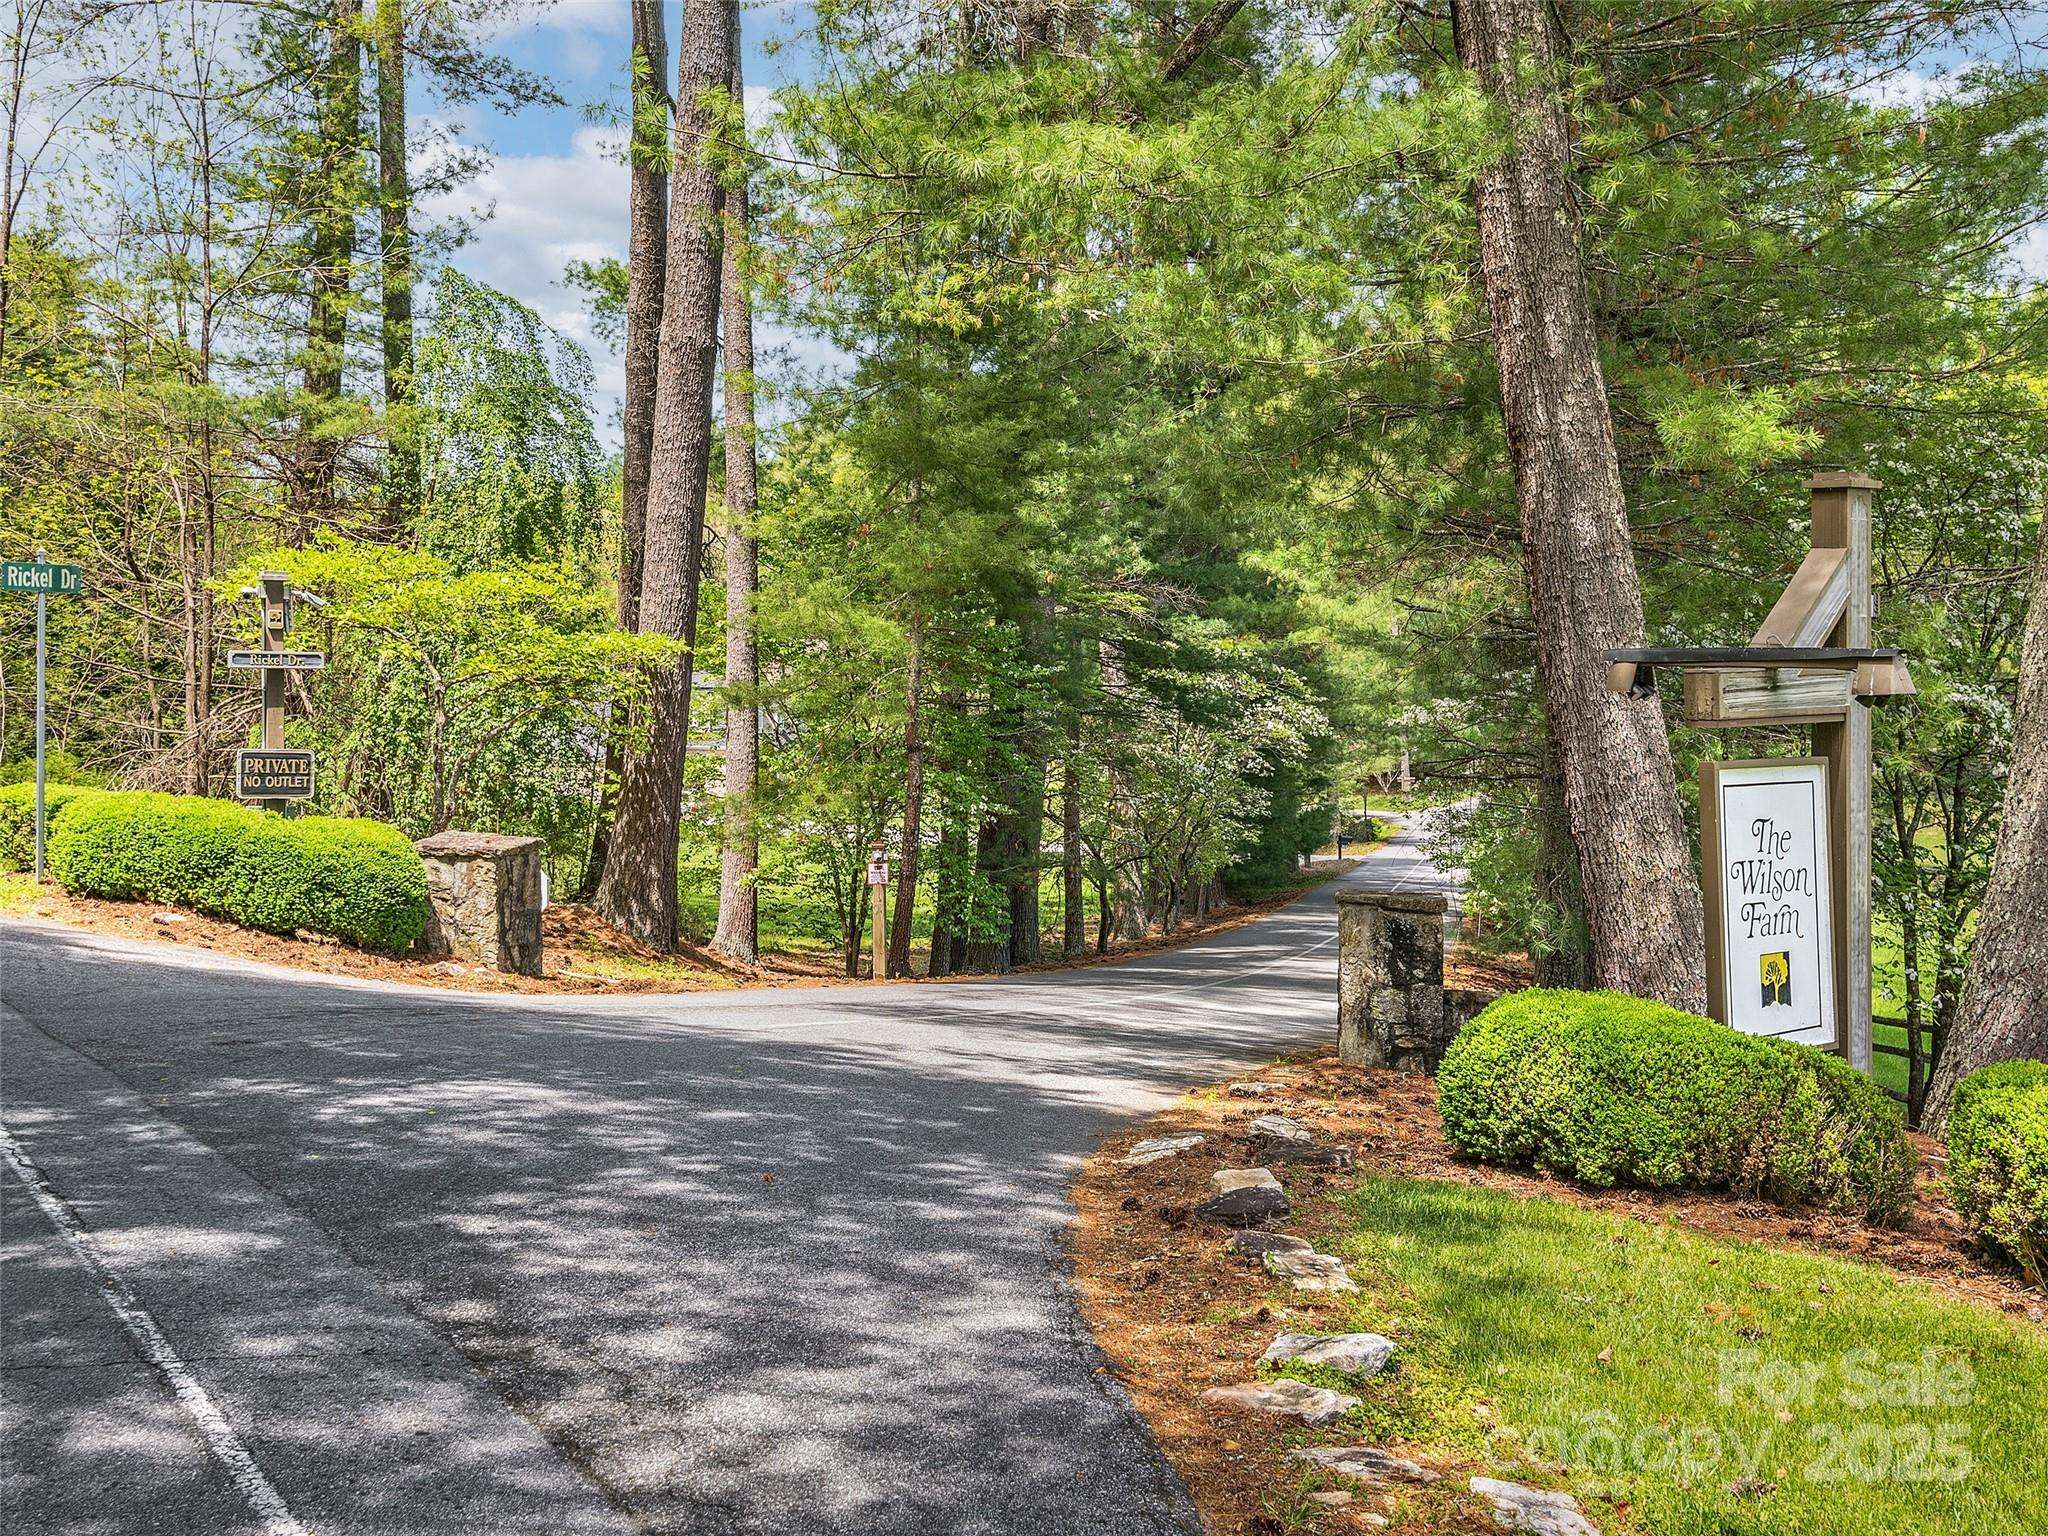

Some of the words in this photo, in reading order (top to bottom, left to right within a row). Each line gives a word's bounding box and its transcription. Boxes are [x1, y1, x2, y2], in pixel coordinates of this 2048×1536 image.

[7, 565, 52, 588] Rickel
[60, 568, 78, 590] Dr
[249, 654, 283, 666] Rickel
[287, 654, 305, 666] Dr.
[244, 758, 309, 775] PRIVATE
[243, 777, 261, 788] NO
[265, 776, 309, 788] OUTLET
[1752, 817, 1792, 860] The
[1730, 859, 1813, 901] Wilson
[1740, 902, 1805, 939] Farm
